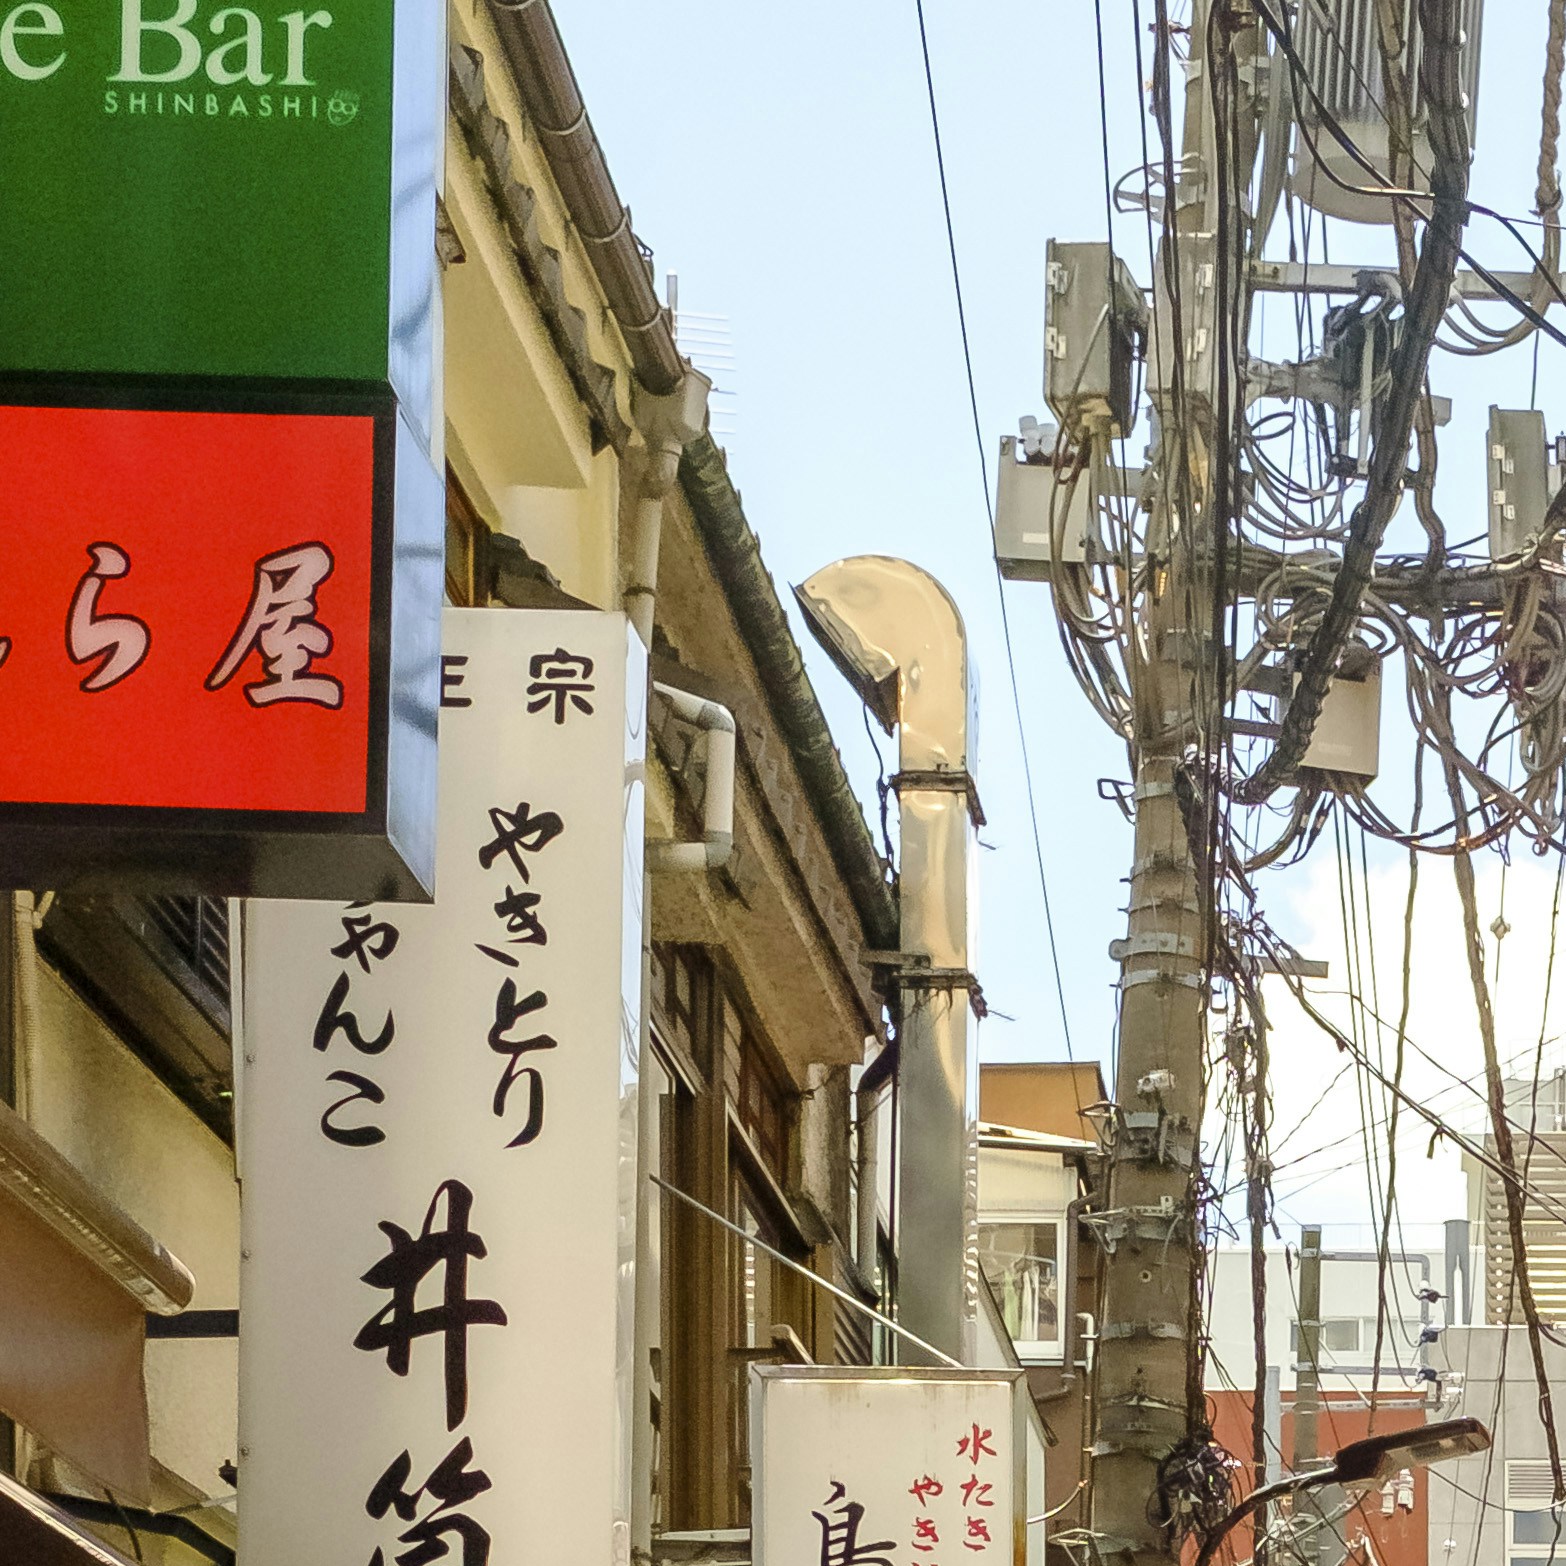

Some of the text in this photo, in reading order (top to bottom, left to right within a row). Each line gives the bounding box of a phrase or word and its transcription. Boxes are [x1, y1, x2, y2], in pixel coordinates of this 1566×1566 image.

[104, 91, 319, 119] SHINBASHI
[107, 0, 333, 87] Bar
[0, 541, 345, 710] ら屋
[313, 898, 400, 1148] ゃんこ
[474, 801, 565, 1150] やきとり
[956, 1422, 998, 1553] 水たき
